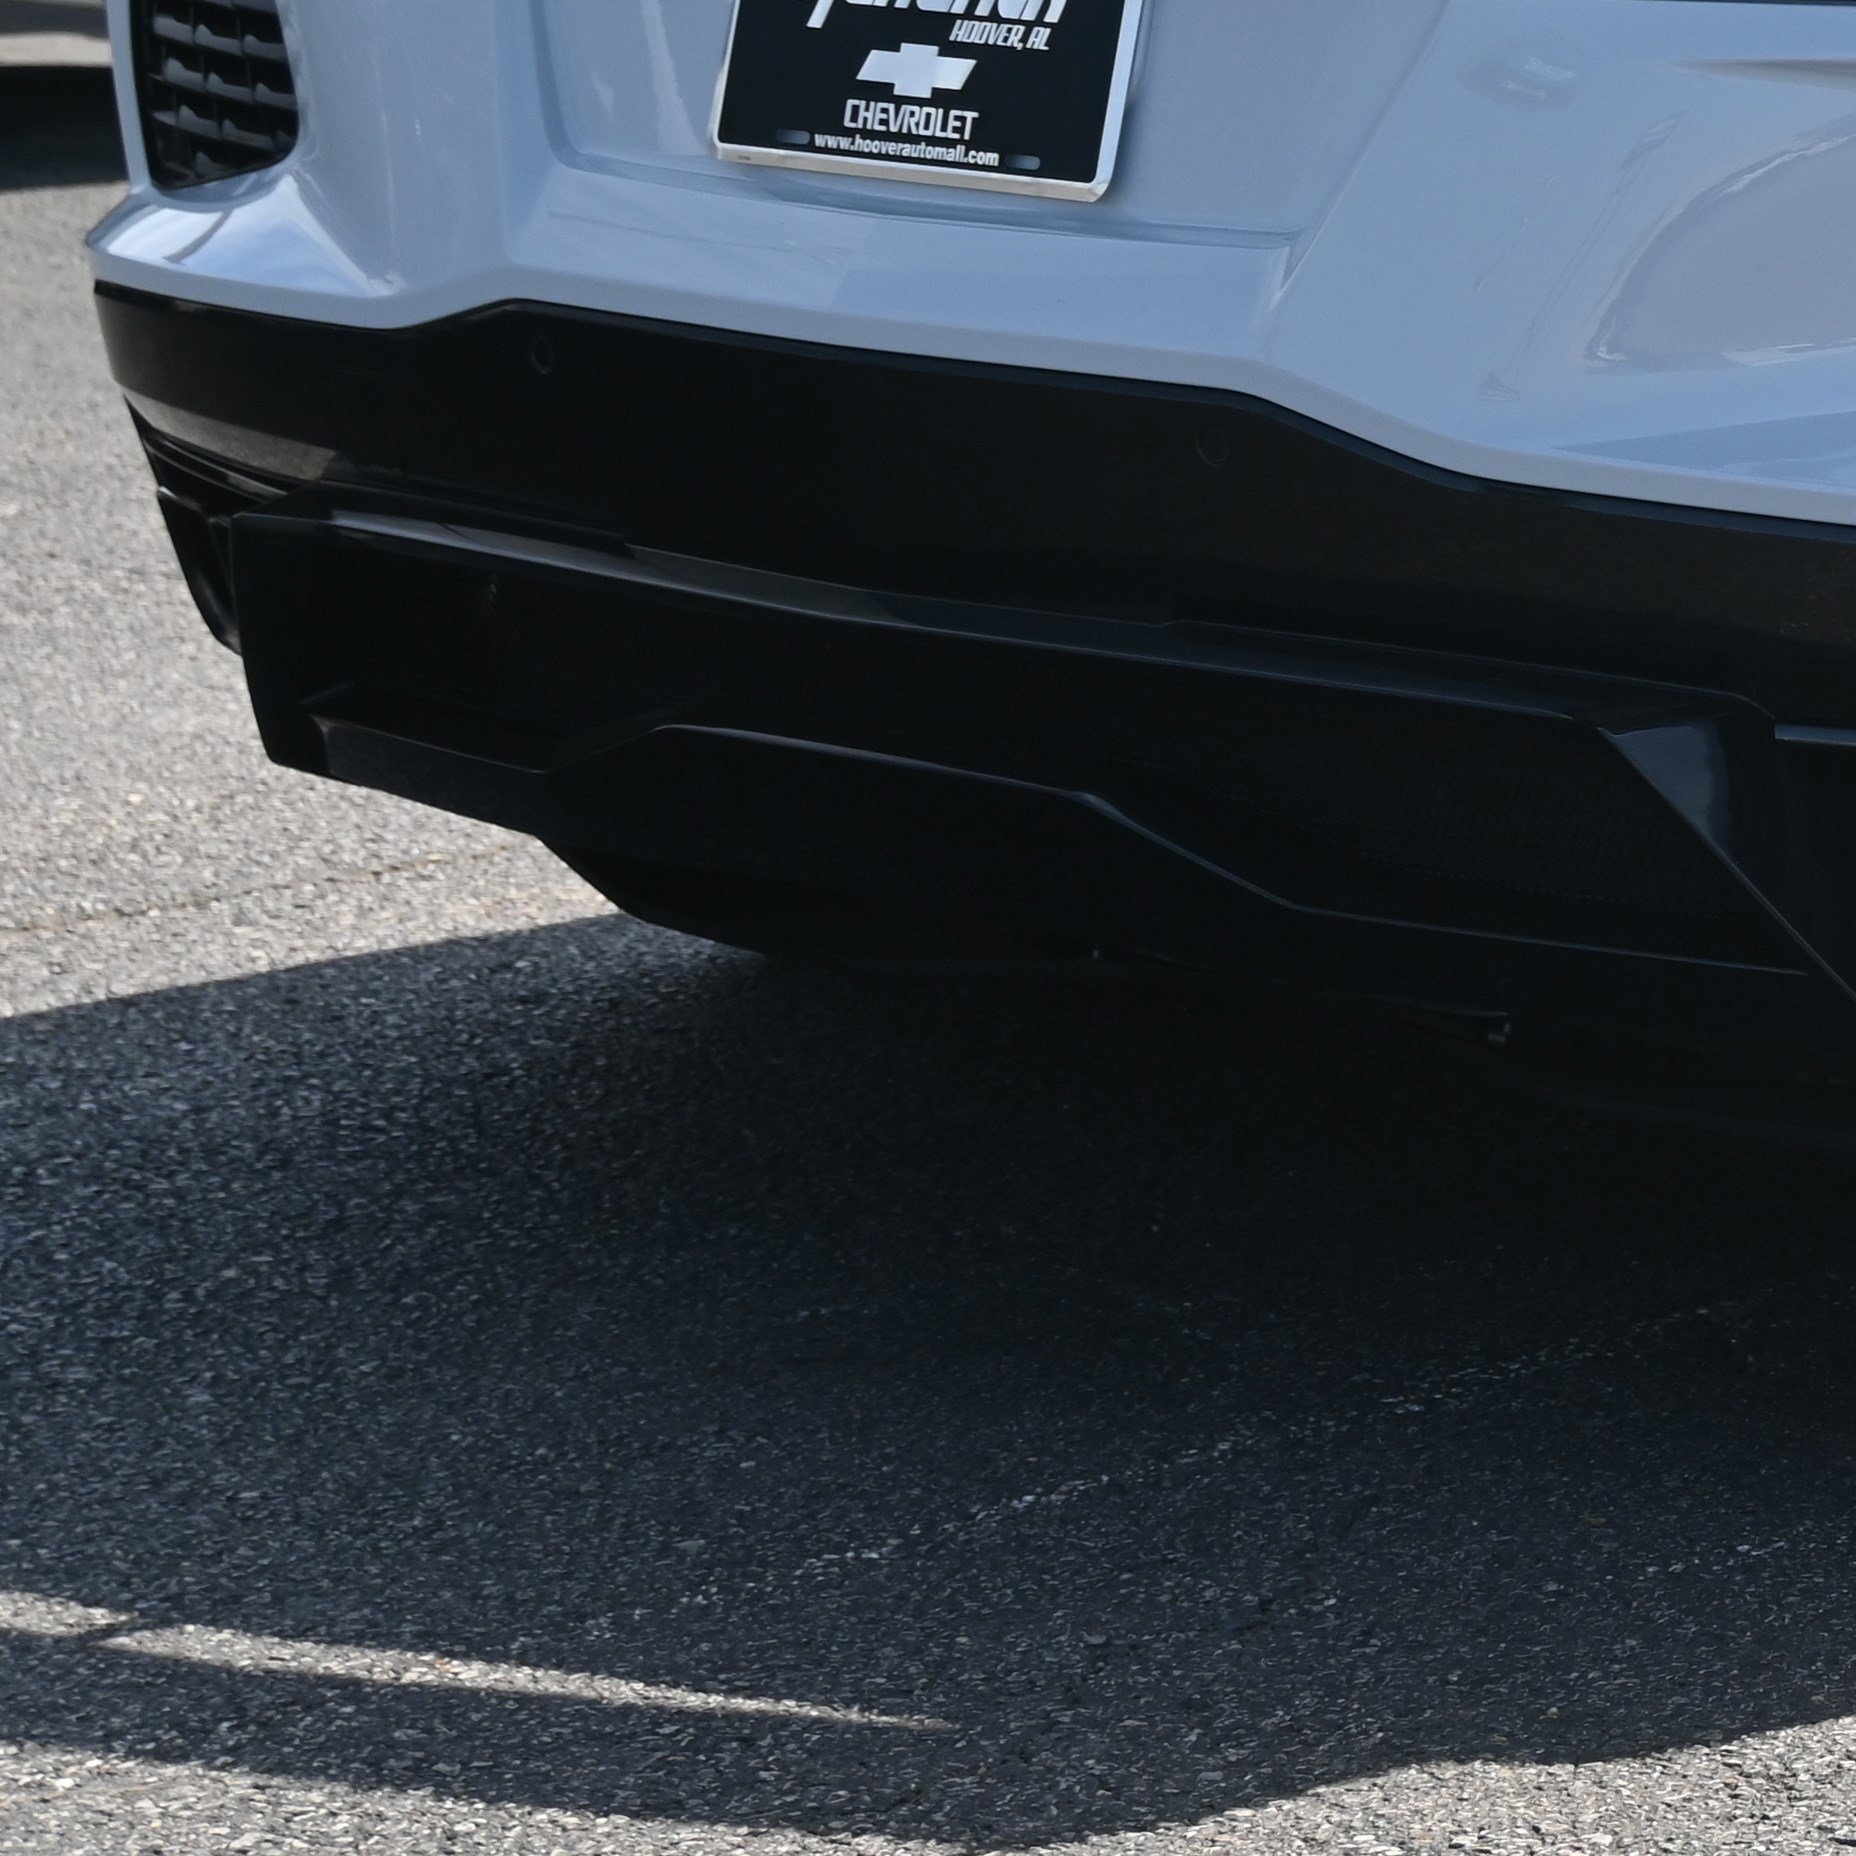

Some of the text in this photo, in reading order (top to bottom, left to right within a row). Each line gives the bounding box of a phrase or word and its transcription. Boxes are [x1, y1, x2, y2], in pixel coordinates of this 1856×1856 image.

[949, 19, 1052, 50] HOOVER, AL
[842, 98, 979, 141] CHEVROLET
[813, 131, 1001, 168] www.hooverautomall.com
